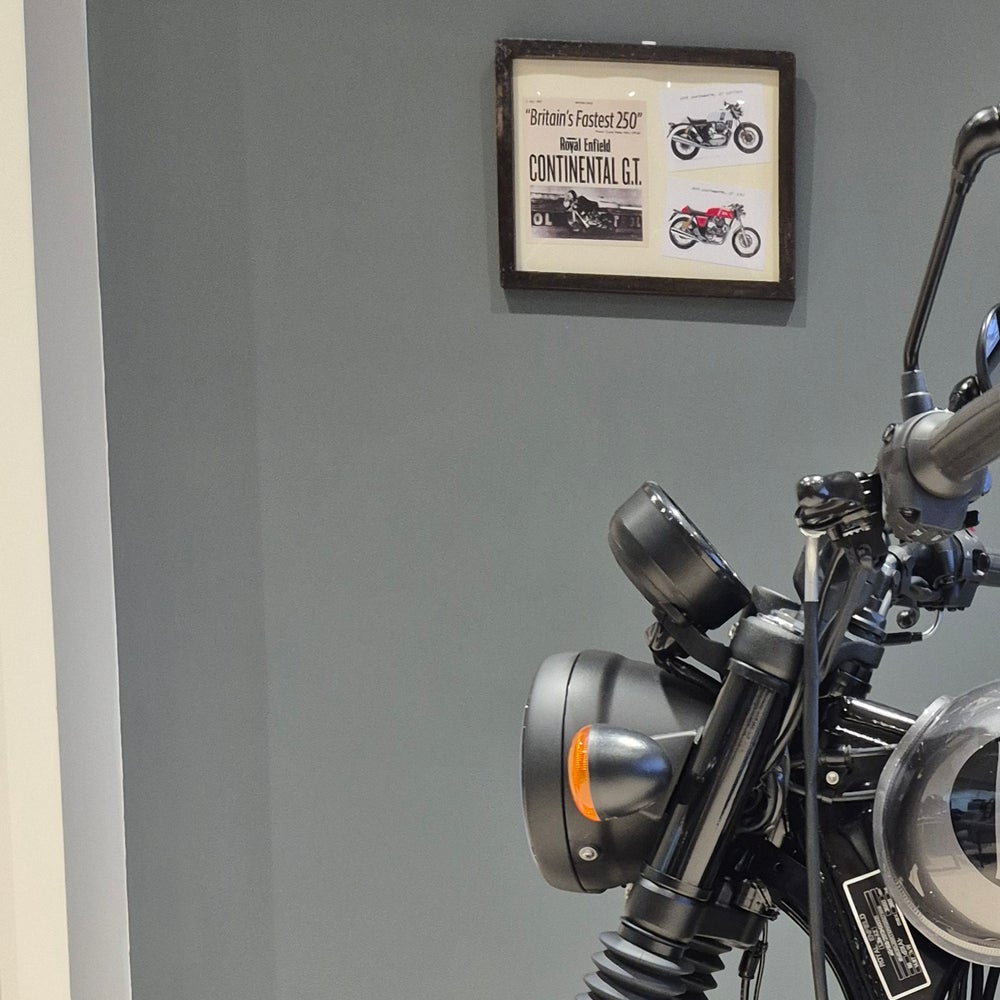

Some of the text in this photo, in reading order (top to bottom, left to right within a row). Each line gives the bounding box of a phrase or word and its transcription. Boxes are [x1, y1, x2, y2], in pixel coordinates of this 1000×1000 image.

[575, 110, 615, 128] Fastest
[560, 137, 611, 153] Royal Enfield
[529, 154, 642, 186] CONTINENTAL G.T.
[873, 943, 886, 968] ROYAL
